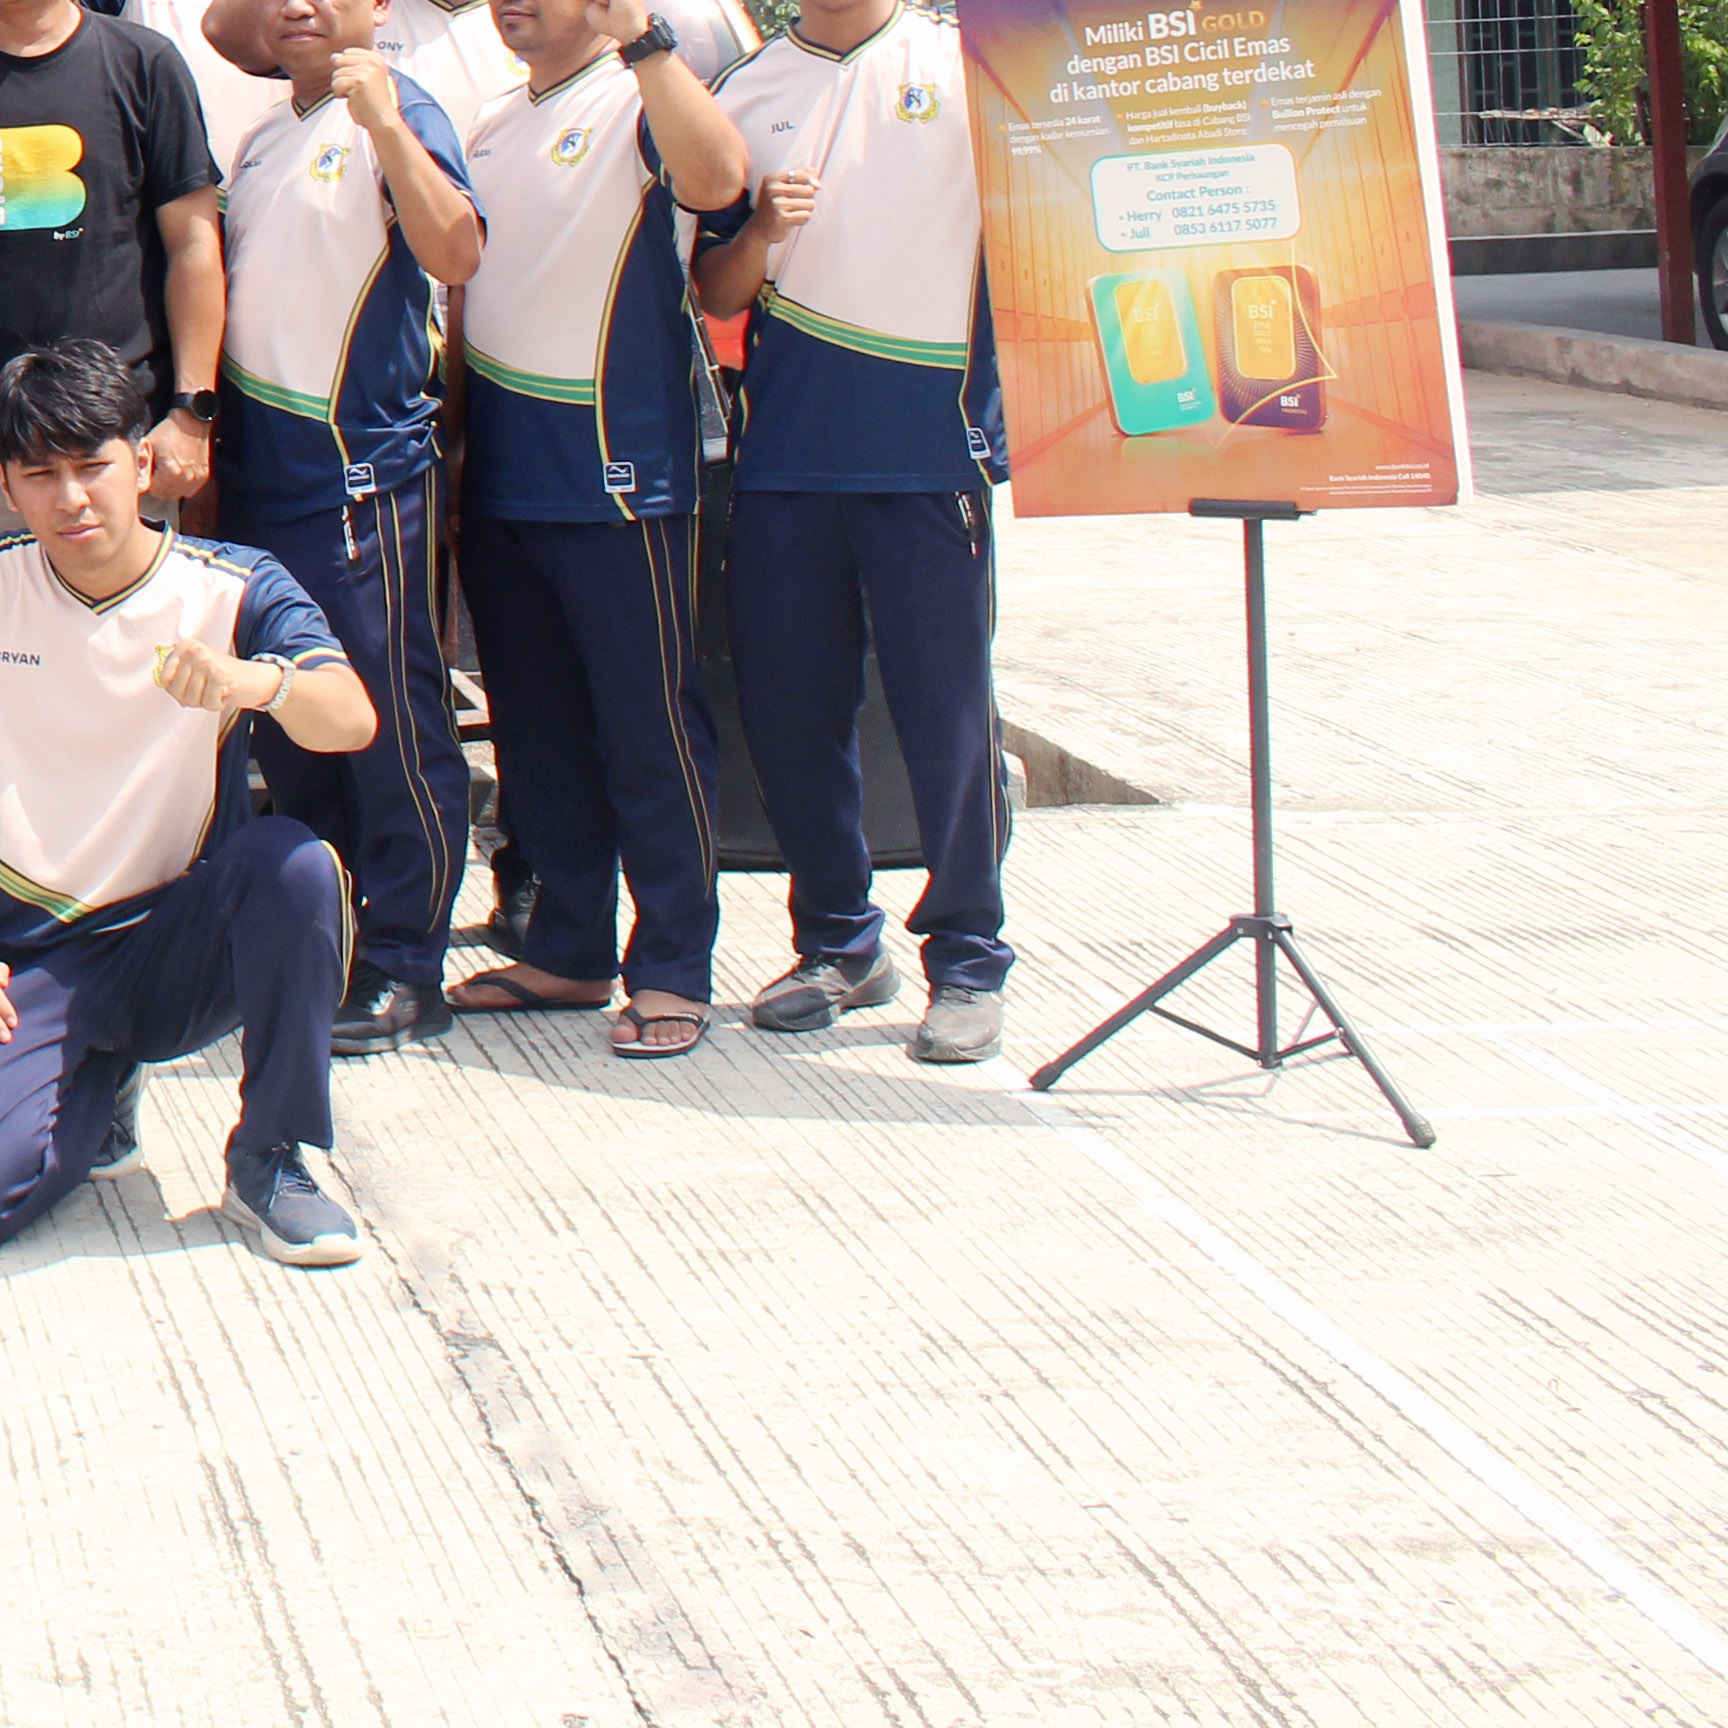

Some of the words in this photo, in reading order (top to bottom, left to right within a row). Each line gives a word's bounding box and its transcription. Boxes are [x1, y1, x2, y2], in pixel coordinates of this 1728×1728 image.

[1084, 20, 1144, 46] Miliki
[1147, 10, 1196, 40] BSI
[1201, 10, 1266, 33] GOLD
[376, 41, 404, 51] ONY
[1066, 53, 1142, 76] dengan
[1144, 44, 1180, 67] BSI
[1183, 38, 1230, 64] Cicil
[1232, 36, 1290, 58] Emas
[1050, 83, 1069, 104] di
[1074, 78, 1140, 102] kantor
[1144, 72, 1220, 94] cabang
[1222, 59, 1316, 86] terdekat
[1270, 97, 1294, 106] Emas
[1295, 92, 1332, 104] terjamin
[1348, 89, 1382, 100] dengan
[1126, 111, 1152, 120] Harga
[1152, 108, 1168, 119] jual
[1168, 104, 1202, 116] kembali
[1202, 99, 1247, 113] (buyback)
[1272, 108, 1304, 120] Bullion
[1306, 105, 1340, 116] Protect
[1342, 102, 1368, 113] untuk
[771, 120, 795, 134] JUL
[1008, 122, 1030, 131] Emas
[1064, 116, 1076, 126] 24
[1077, 115, 1102, 124] karat
[1126, 120, 1174, 132] kompetitif
[1174, 119, 1192, 128] bisa
[1192, 118, 1201, 127] di
[1202, 115, 1236, 126] Cabang
[1236, 112, 1251, 123] BSI
[1273, 120, 1318, 132] mencegah
[1319, 116, 1368, 129] pemalsuan
[1010, 134, 1040, 144] dengan
[1128, 136, 1144, 145] dan
[1197, 128, 1222, 139] Abadi
[1224, 127, 1247, 136] Store
[1127, 162, 1142, 172] PT.
[1144, 160, 1168, 171] Bank
[1170, 157, 1206, 170] Syariah
[1208, 152, 1256, 165] Indonesia
[1156, 173, 1175, 182] KCP
[1176, 169, 1230, 182] Perbaungan
[1147, 188, 1196, 202] Contact
[1198, 184, 1242, 198] Person
[1126, 210, 1162, 223] Herry
[1172, 206, 1204, 219] 0821
[1208, 203, 1240, 216] 6475
[1243, 200, 1276, 214] 5735
[1130, 227, 1151, 240] Juli
[1174, 222, 1206, 236] 0853
[1210, 219, 1242, 232] 6117
[1245, 218, 1278, 230] 5077
[1248, 304, 1273, 320] BSI
[1176, 391, 1194, 403] BSI
[1280, 396, 1299, 408] BSI
